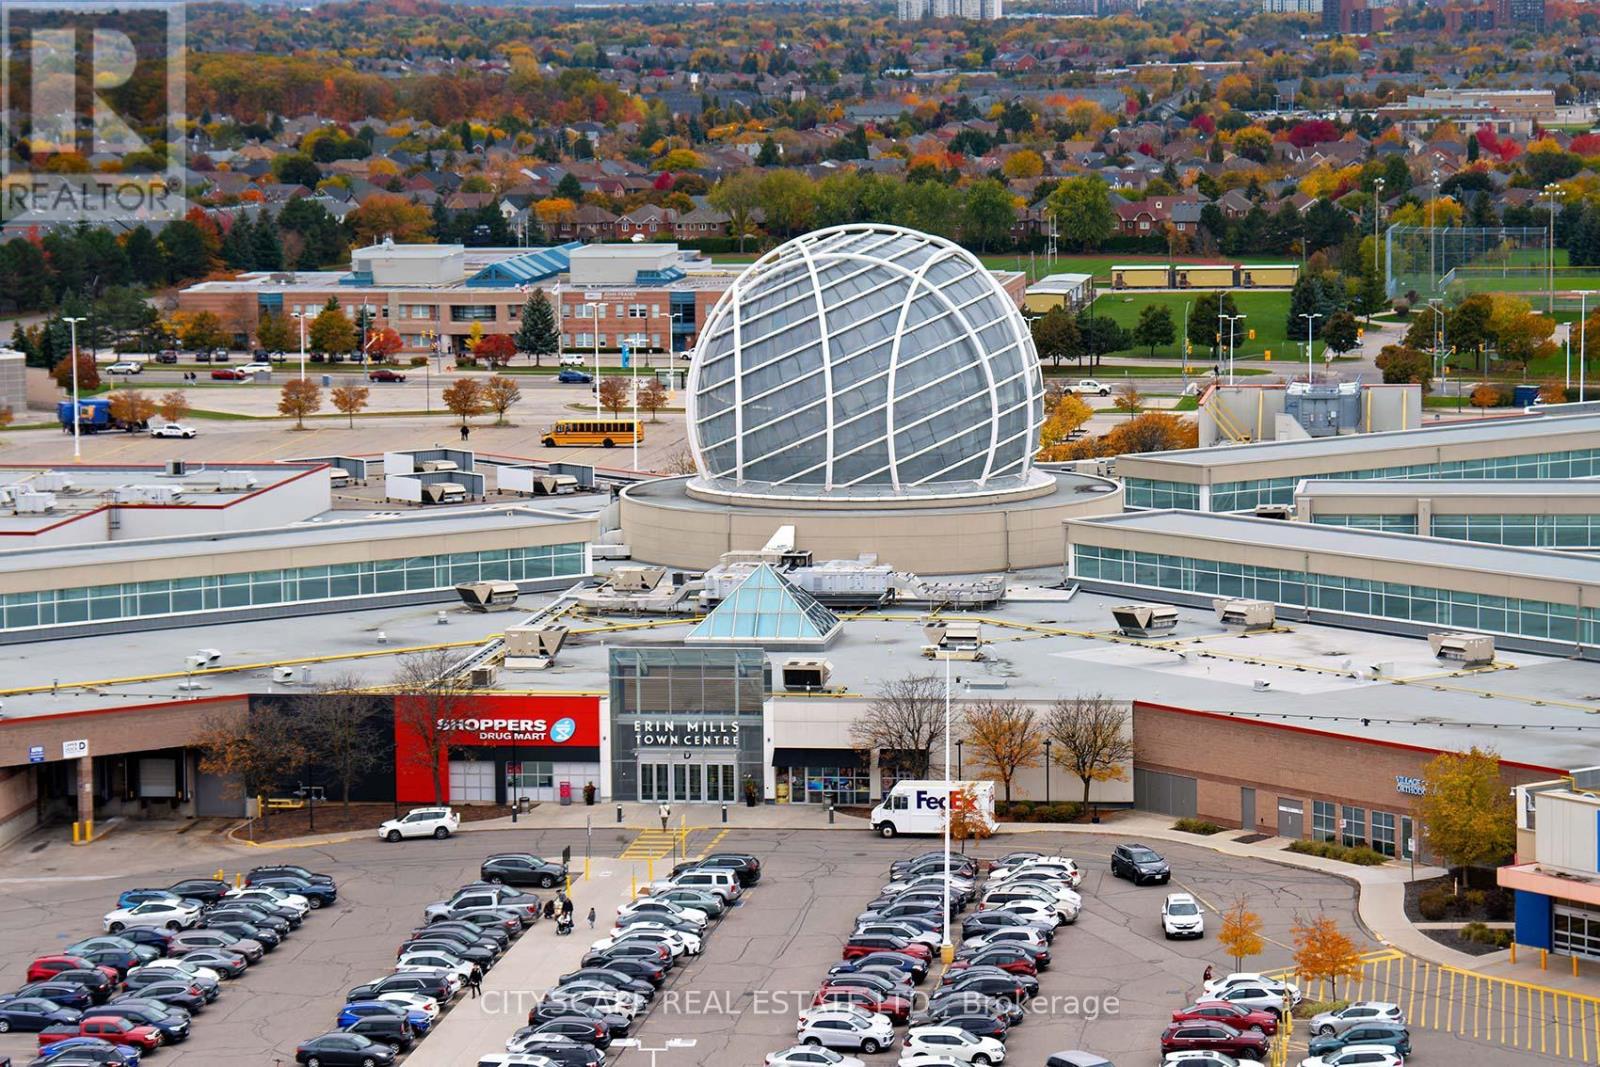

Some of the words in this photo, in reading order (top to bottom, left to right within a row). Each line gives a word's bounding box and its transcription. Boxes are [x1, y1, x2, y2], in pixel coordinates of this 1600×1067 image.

[436, 718, 547, 731] SHOPPERS
[634, 720, 675, 732] ERIN
[687, 720, 740, 733] MILLS
[479, 732, 512, 741] DRUG
[513, 732, 546, 741] MART
[635, 734, 678, 745] TOWN
[683, 735, 739, 745] CENTRE
[683, 750, 692, 760] D
